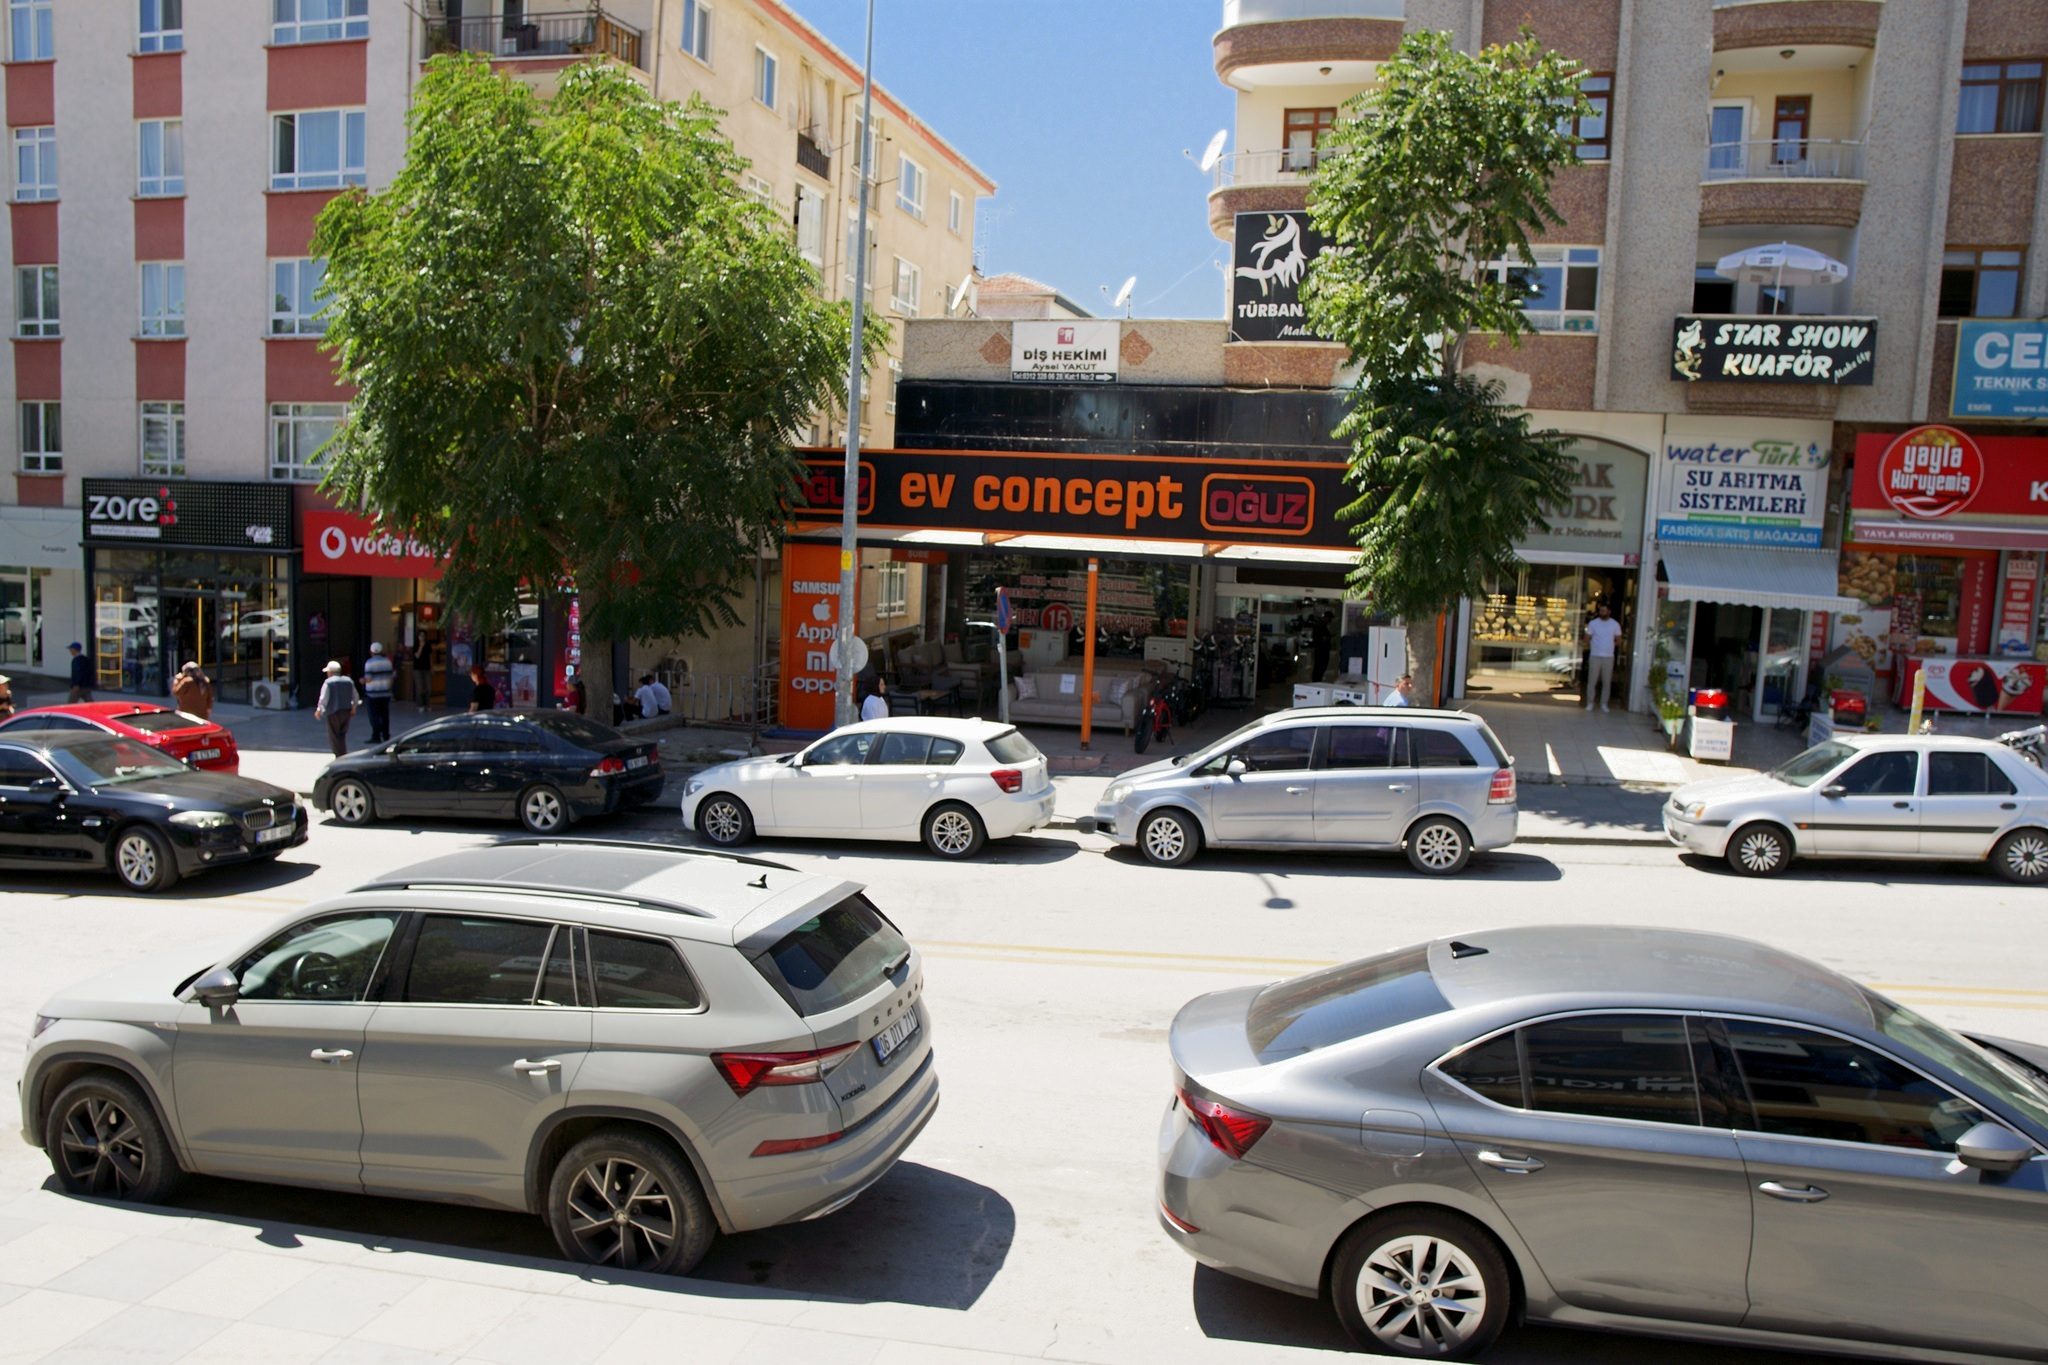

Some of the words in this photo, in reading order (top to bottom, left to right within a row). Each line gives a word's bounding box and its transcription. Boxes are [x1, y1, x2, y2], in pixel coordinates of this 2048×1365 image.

[1238, 301, 1304, 318] TÜRBAN
[1714, 323, 1781, 347] STAR
[1787, 324, 1869, 349] SHOW
[1023, 348, 1048, 362] DİŞ
[1052, 348, 1107, 361] HEKİMİ
[1974, 331, 2048, 370] CE
[1062, 363, 1097, 371] YAKUT
[1721, 349, 1833, 379] KUAFÖR
[1667, 443, 1749, 463] water
[1752, 439, 1802, 465] Türk
[1903, 442, 1963, 474] yayla
[1686, 470, 1713, 487] SU
[1718, 471, 1803, 491] ARITMA
[1891, 469, 1971, 497] Kuruyemiş
[89, 495, 160, 521] zore
[900, 472, 956, 508] ev
[973, 475, 1183, 530] concept
[1209, 484, 1306, 525] OĞUZ
[1679, 488, 1807, 514] SİSTEMLERİ
[1661, 524, 1714, 537] FABRİKA
[1716, 527, 1750, 540] SATIŞ
[1753, 528, 1818, 544] MAĞAZASI
[1863, 529, 1896, 539] YAYLA
[1049, 609, 1067, 631] 15
[879, 1033, 890, 1054] 06
